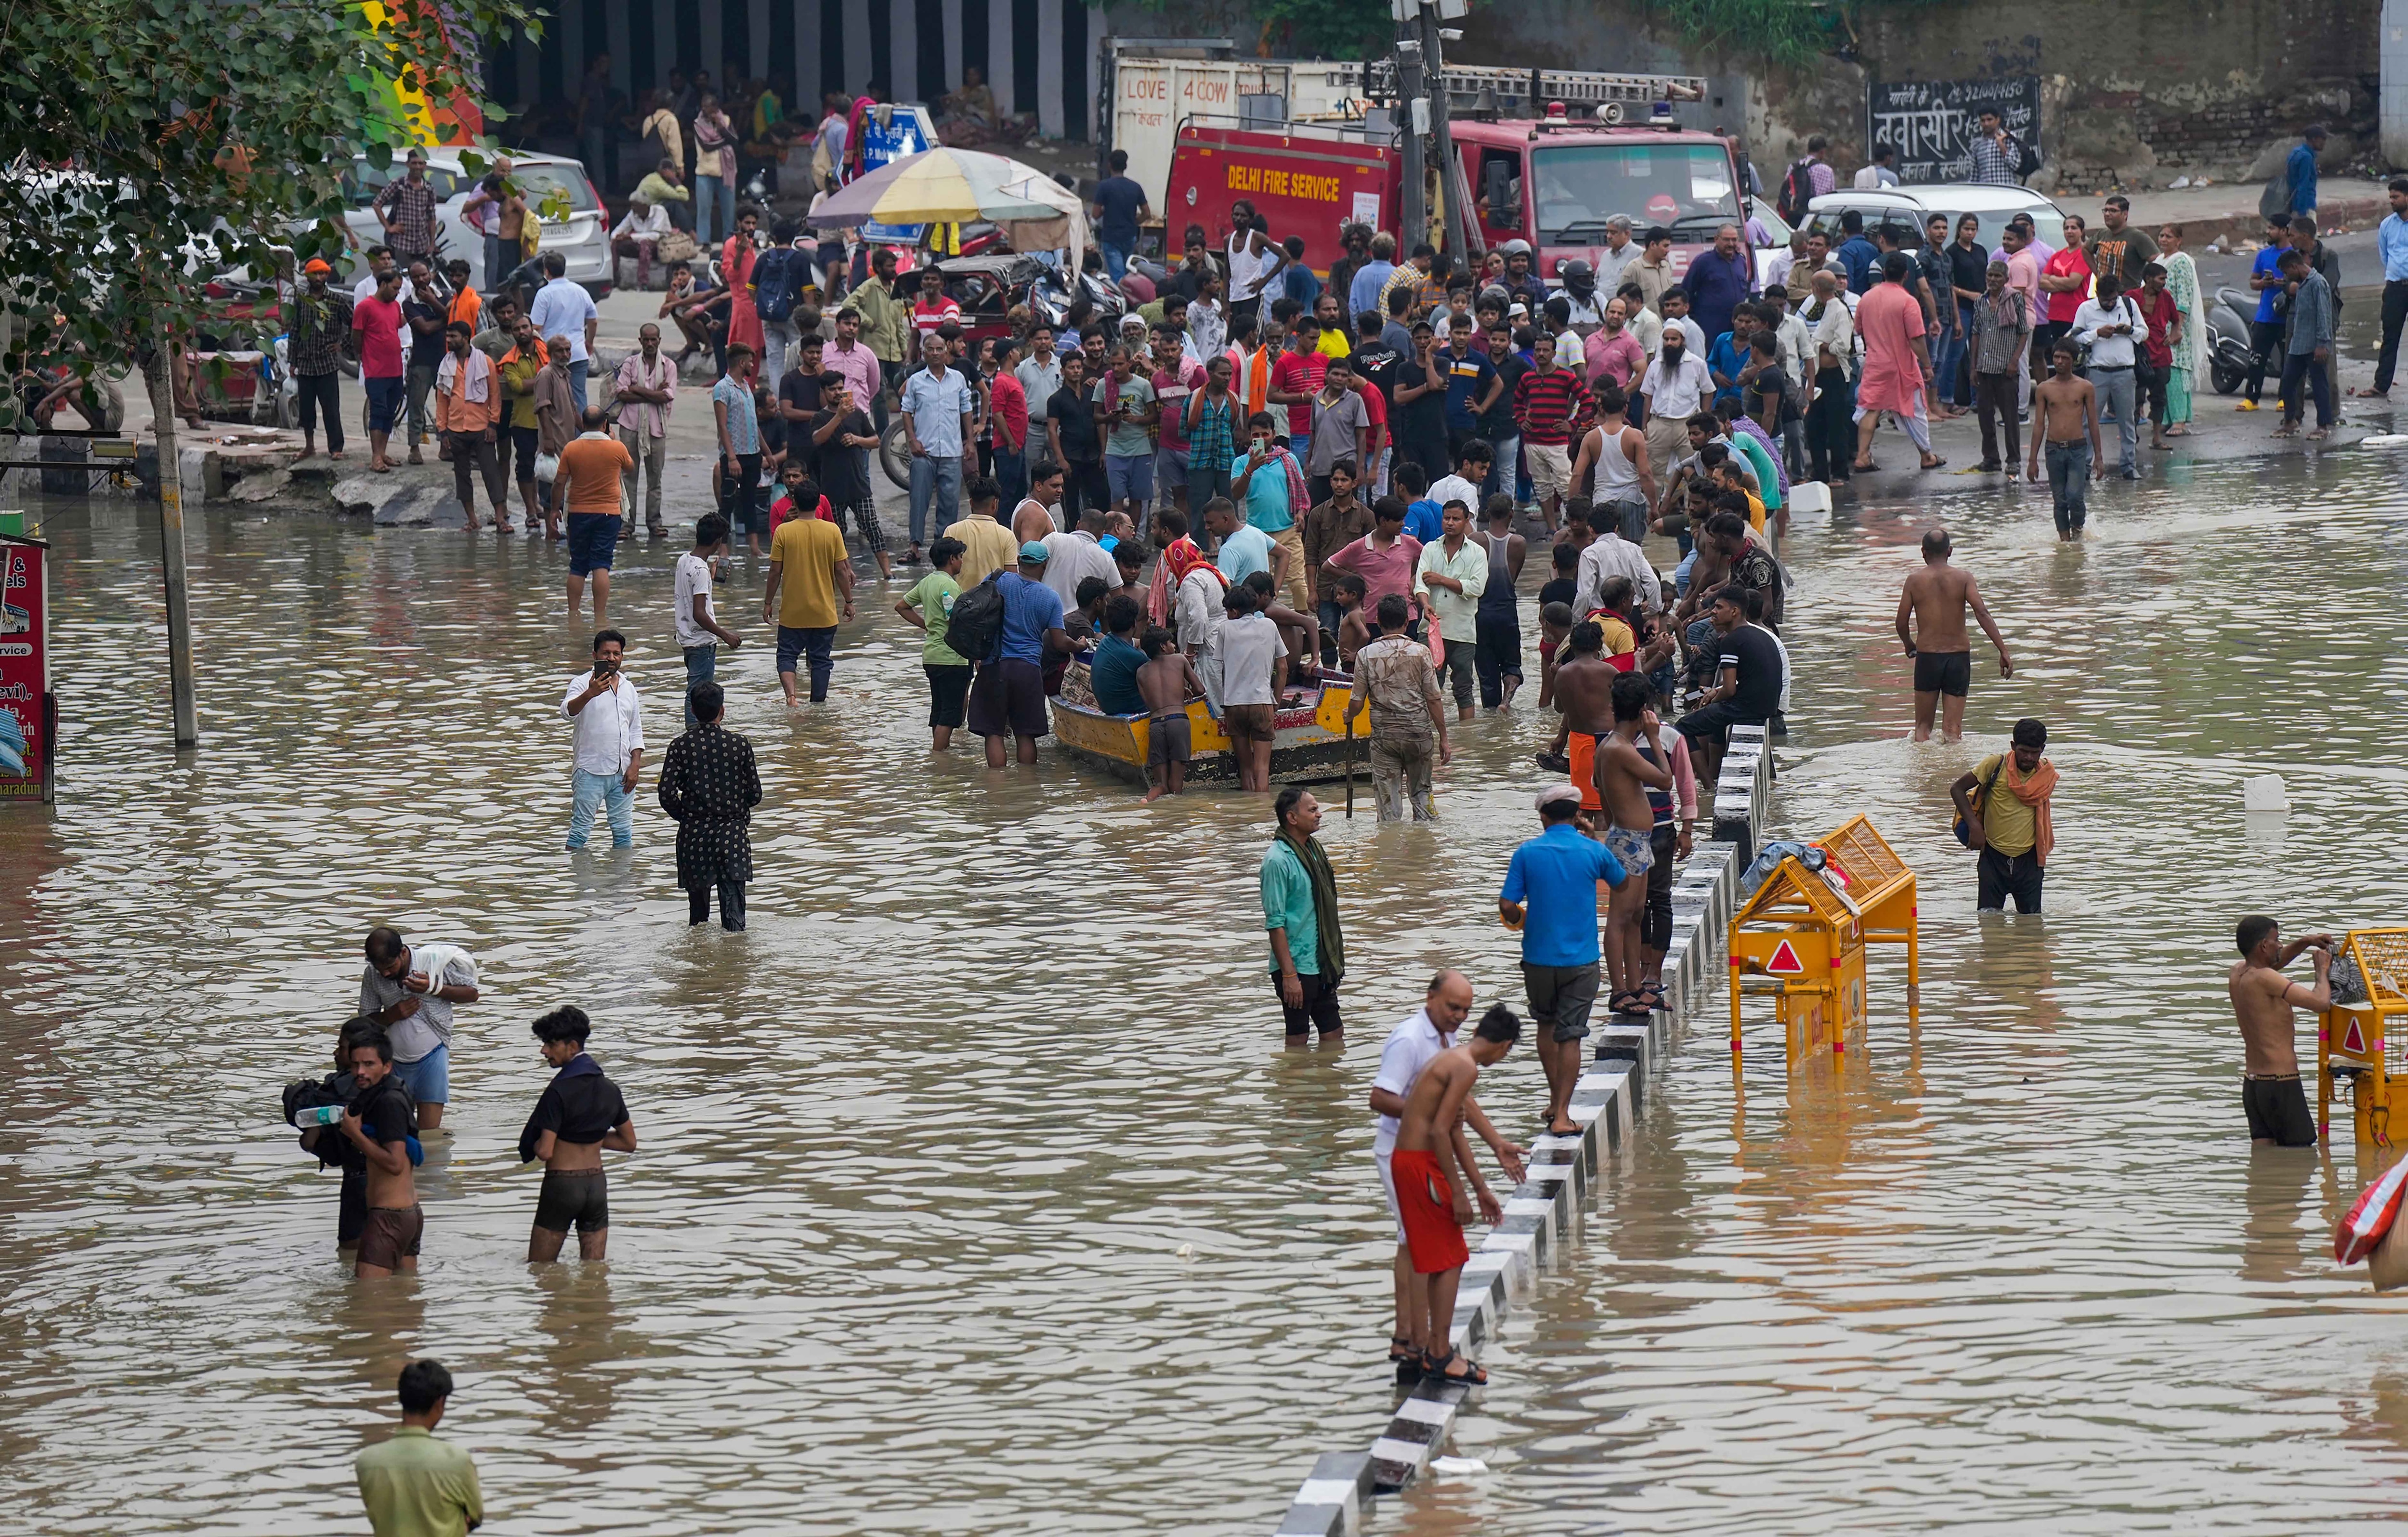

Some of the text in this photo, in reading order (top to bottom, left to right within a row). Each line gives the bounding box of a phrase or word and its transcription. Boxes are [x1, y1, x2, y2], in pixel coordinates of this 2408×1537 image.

[1128, 80, 1166, 99] LOVE
[1184, 81, 1193, 100] 4
[1197, 81, 1228, 103] COW
[1228, 164, 1340, 202] DELHI FIRE SERVICE
[1360, 350, 1397, 364] Reebok
[13, 557, 26, 572] &
[0, 646, 27, 655] rvice
[0, 682, 33, 702] evi),
